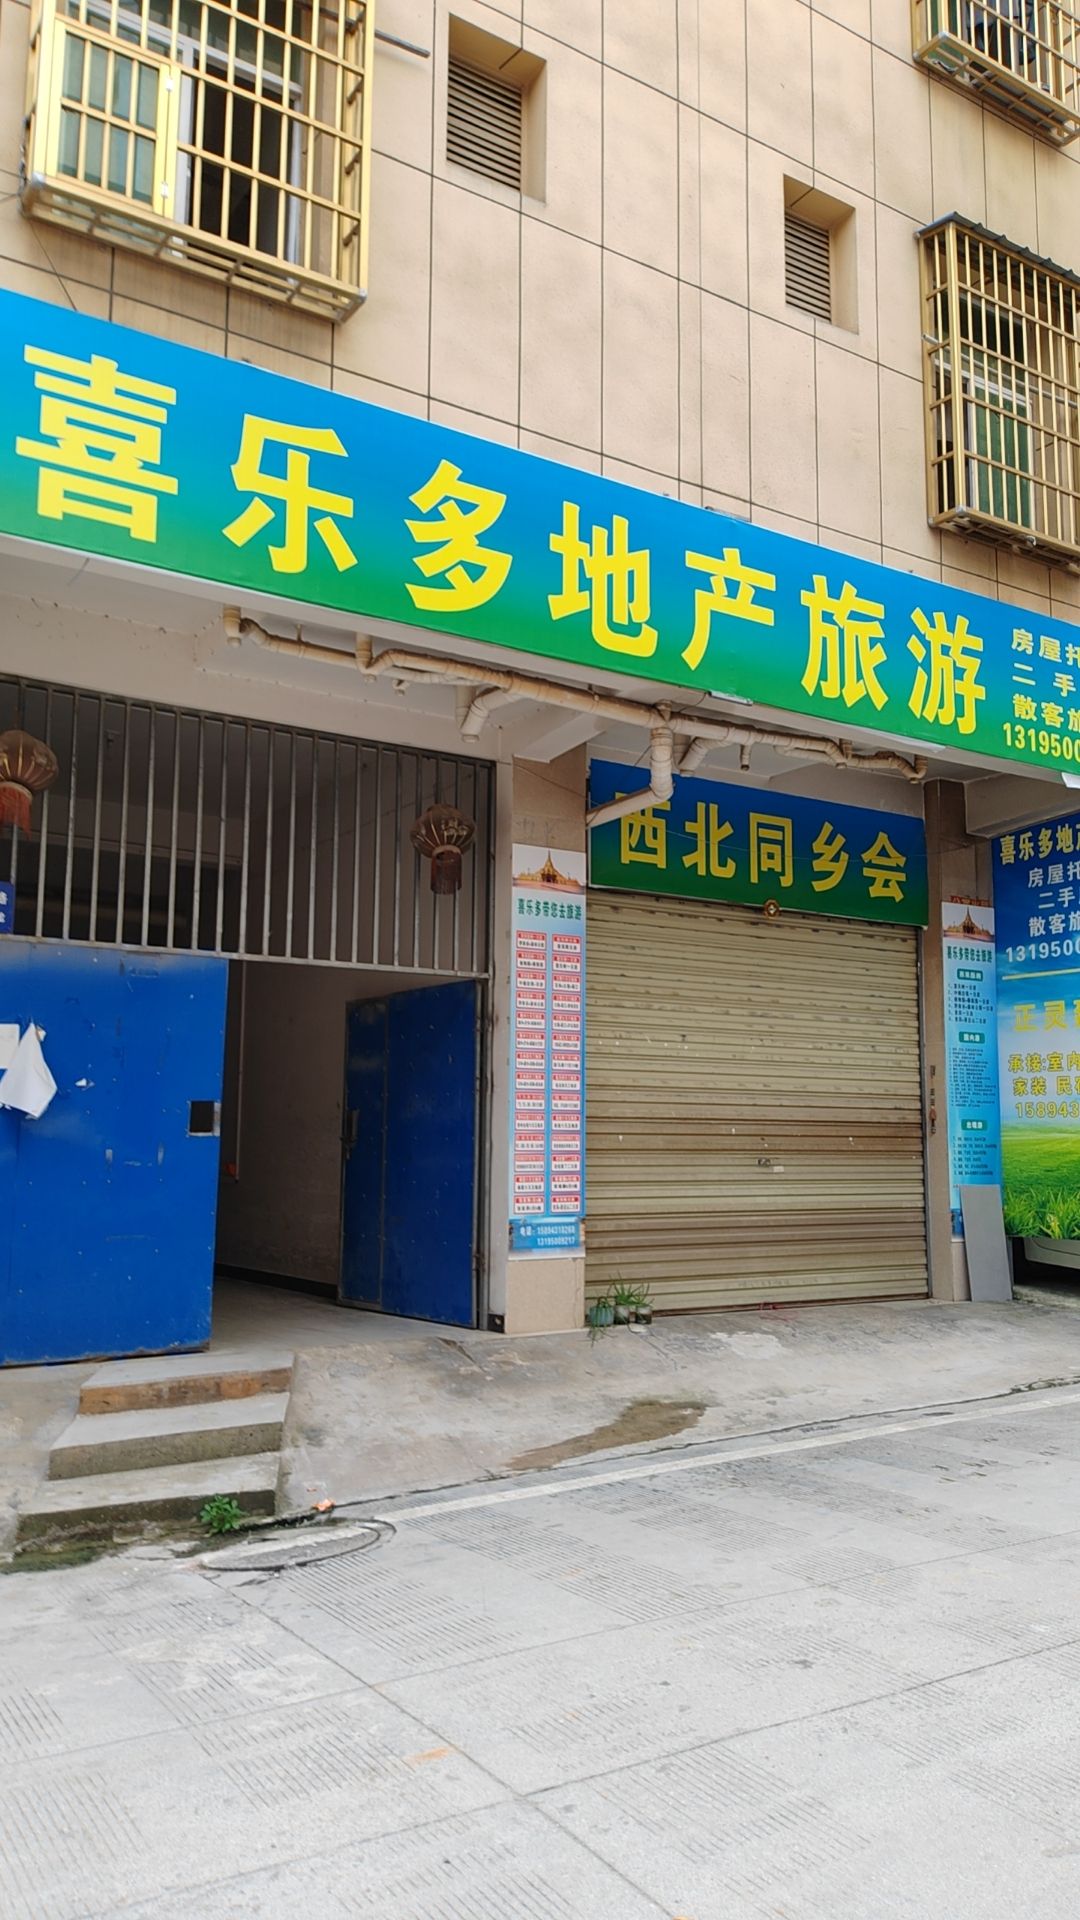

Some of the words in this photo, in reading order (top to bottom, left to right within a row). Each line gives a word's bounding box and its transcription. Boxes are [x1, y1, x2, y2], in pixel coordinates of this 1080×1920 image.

[15, 343, 986, 735] 喜乐多地产旅游
[615, 792, 907, 903] 西北同乡会
[1000, 823, 1080, 866] 喜乐多地
[1028, 861, 1080, 888] 房屋托
[1038, 886, 1080, 909] 二手
[1013, 999, 1080, 1032] 正灵
